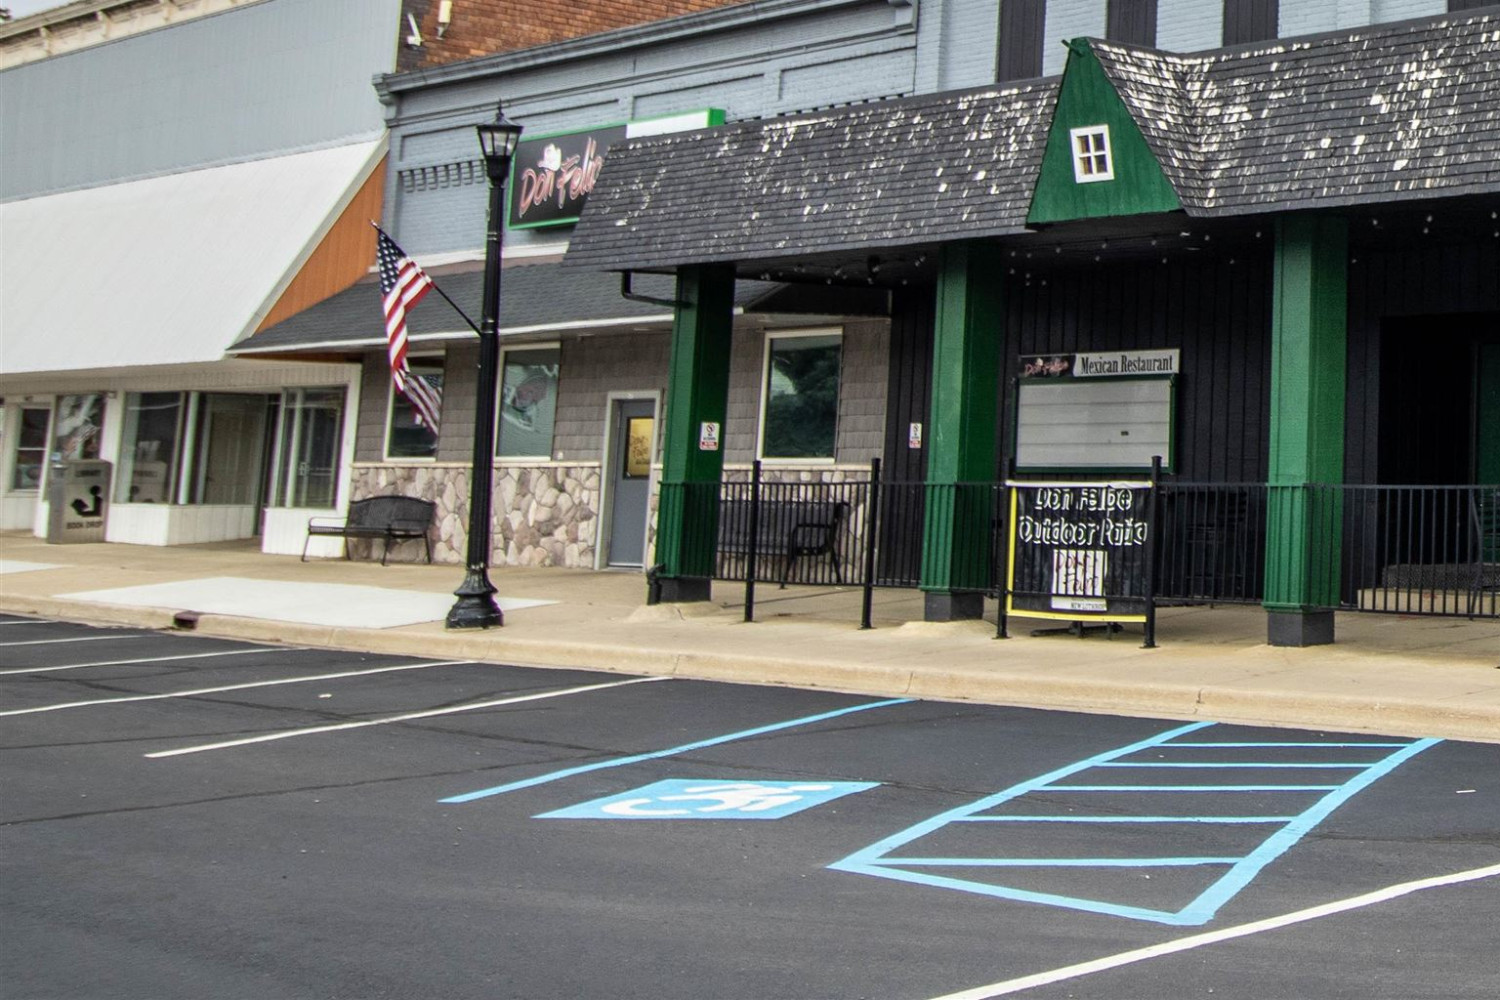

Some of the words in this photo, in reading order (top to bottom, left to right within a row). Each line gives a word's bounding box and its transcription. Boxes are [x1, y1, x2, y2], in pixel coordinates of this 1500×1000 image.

[518, 166, 557, 218] Don
[556, 136, 605, 210] Felip
[1081, 356, 1119, 375] Mexican
[1120, 353, 1173, 373] Restaurant
[1034, 487, 1074, 511] Don
[66, 521, 85, 530] BOOK
[86, 520, 104, 529] DROP
[1018, 515, 1099, 546] Outdoor
[1100, 516, 1148, 546] Patio
